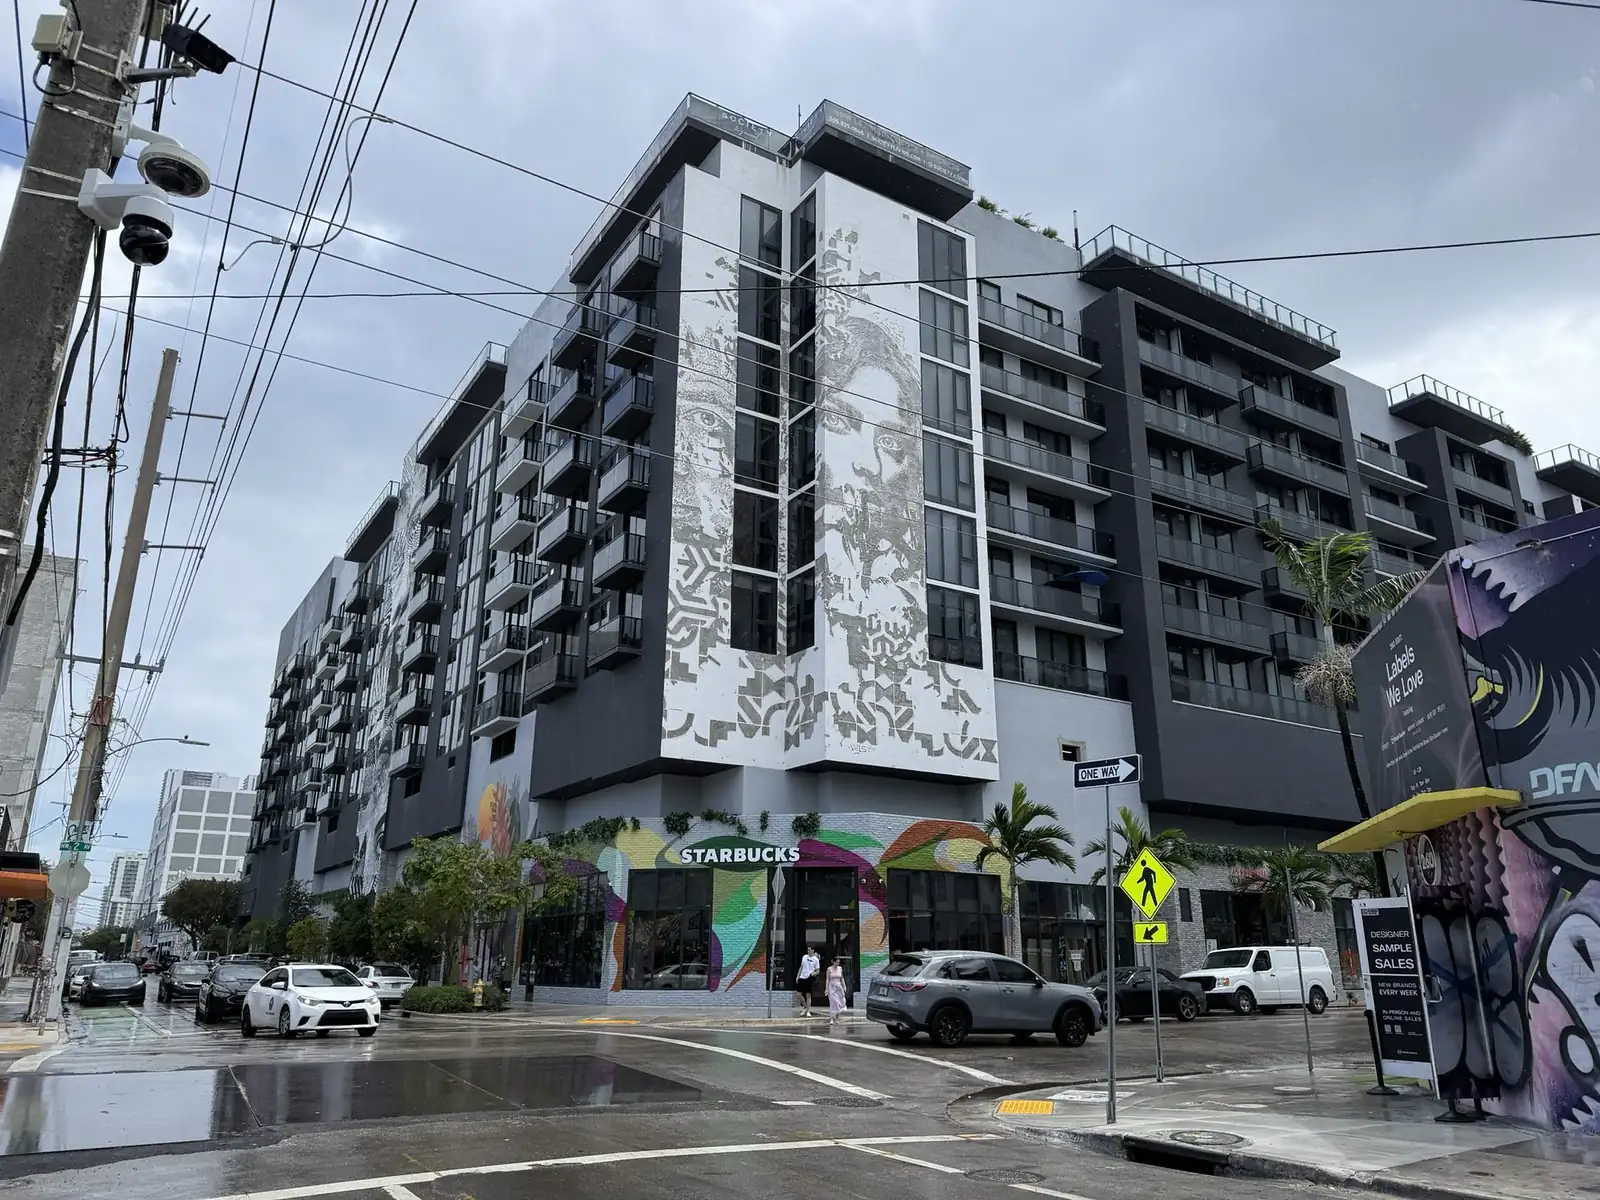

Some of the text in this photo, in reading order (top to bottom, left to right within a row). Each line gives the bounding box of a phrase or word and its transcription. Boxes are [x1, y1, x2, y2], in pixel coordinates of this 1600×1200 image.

[721, 112, 772, 137] SOCIETY
[1385, 645, 1415, 682] Labels
[1385, 669, 1424, 708] We Love
[1080, 765, 1119, 780] ONE WAY
[681, 847, 800, 864] STARBUCKS
[1420, 851, 1435, 870] 260
[1372, 944, 1413, 953] SAMPLE
[1375, 958, 1415, 969] SALES
